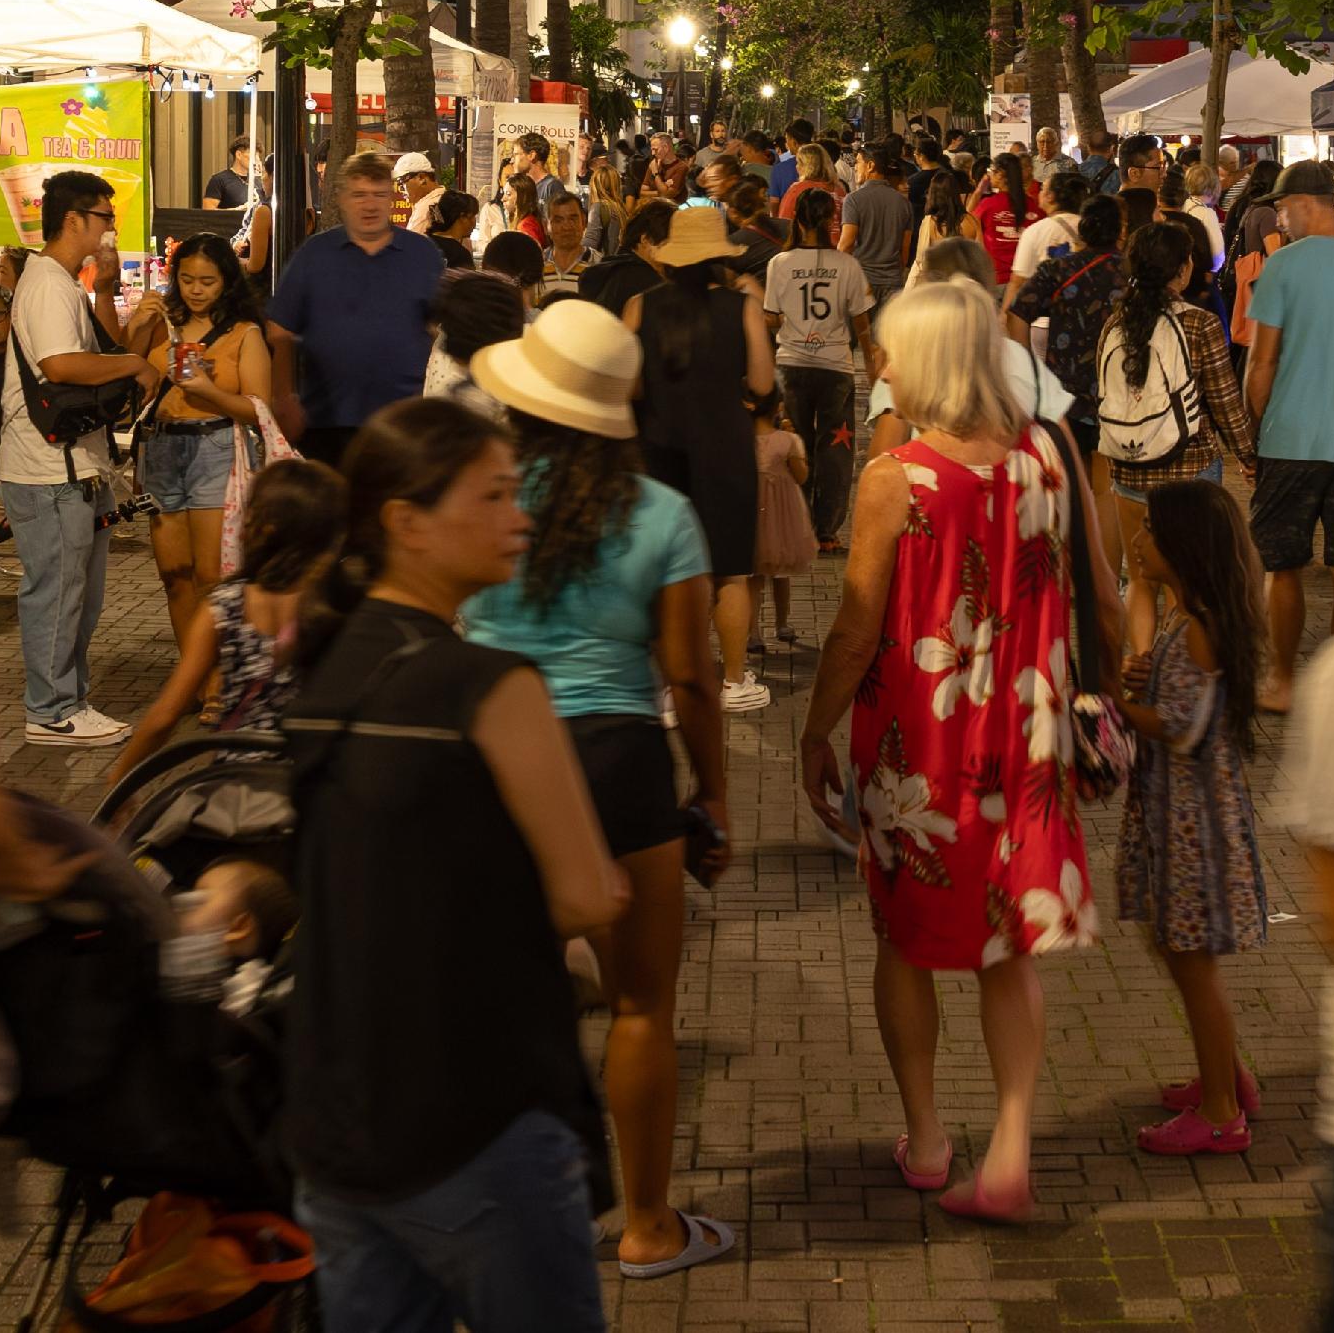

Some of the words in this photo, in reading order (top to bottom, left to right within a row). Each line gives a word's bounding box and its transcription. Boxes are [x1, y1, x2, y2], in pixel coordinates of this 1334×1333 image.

[43, 137, 72, 158] TEA
[77, 138, 90, 158] &
[95, 139, 141, 160] FRUIT
[798, 281, 832, 321] 15
